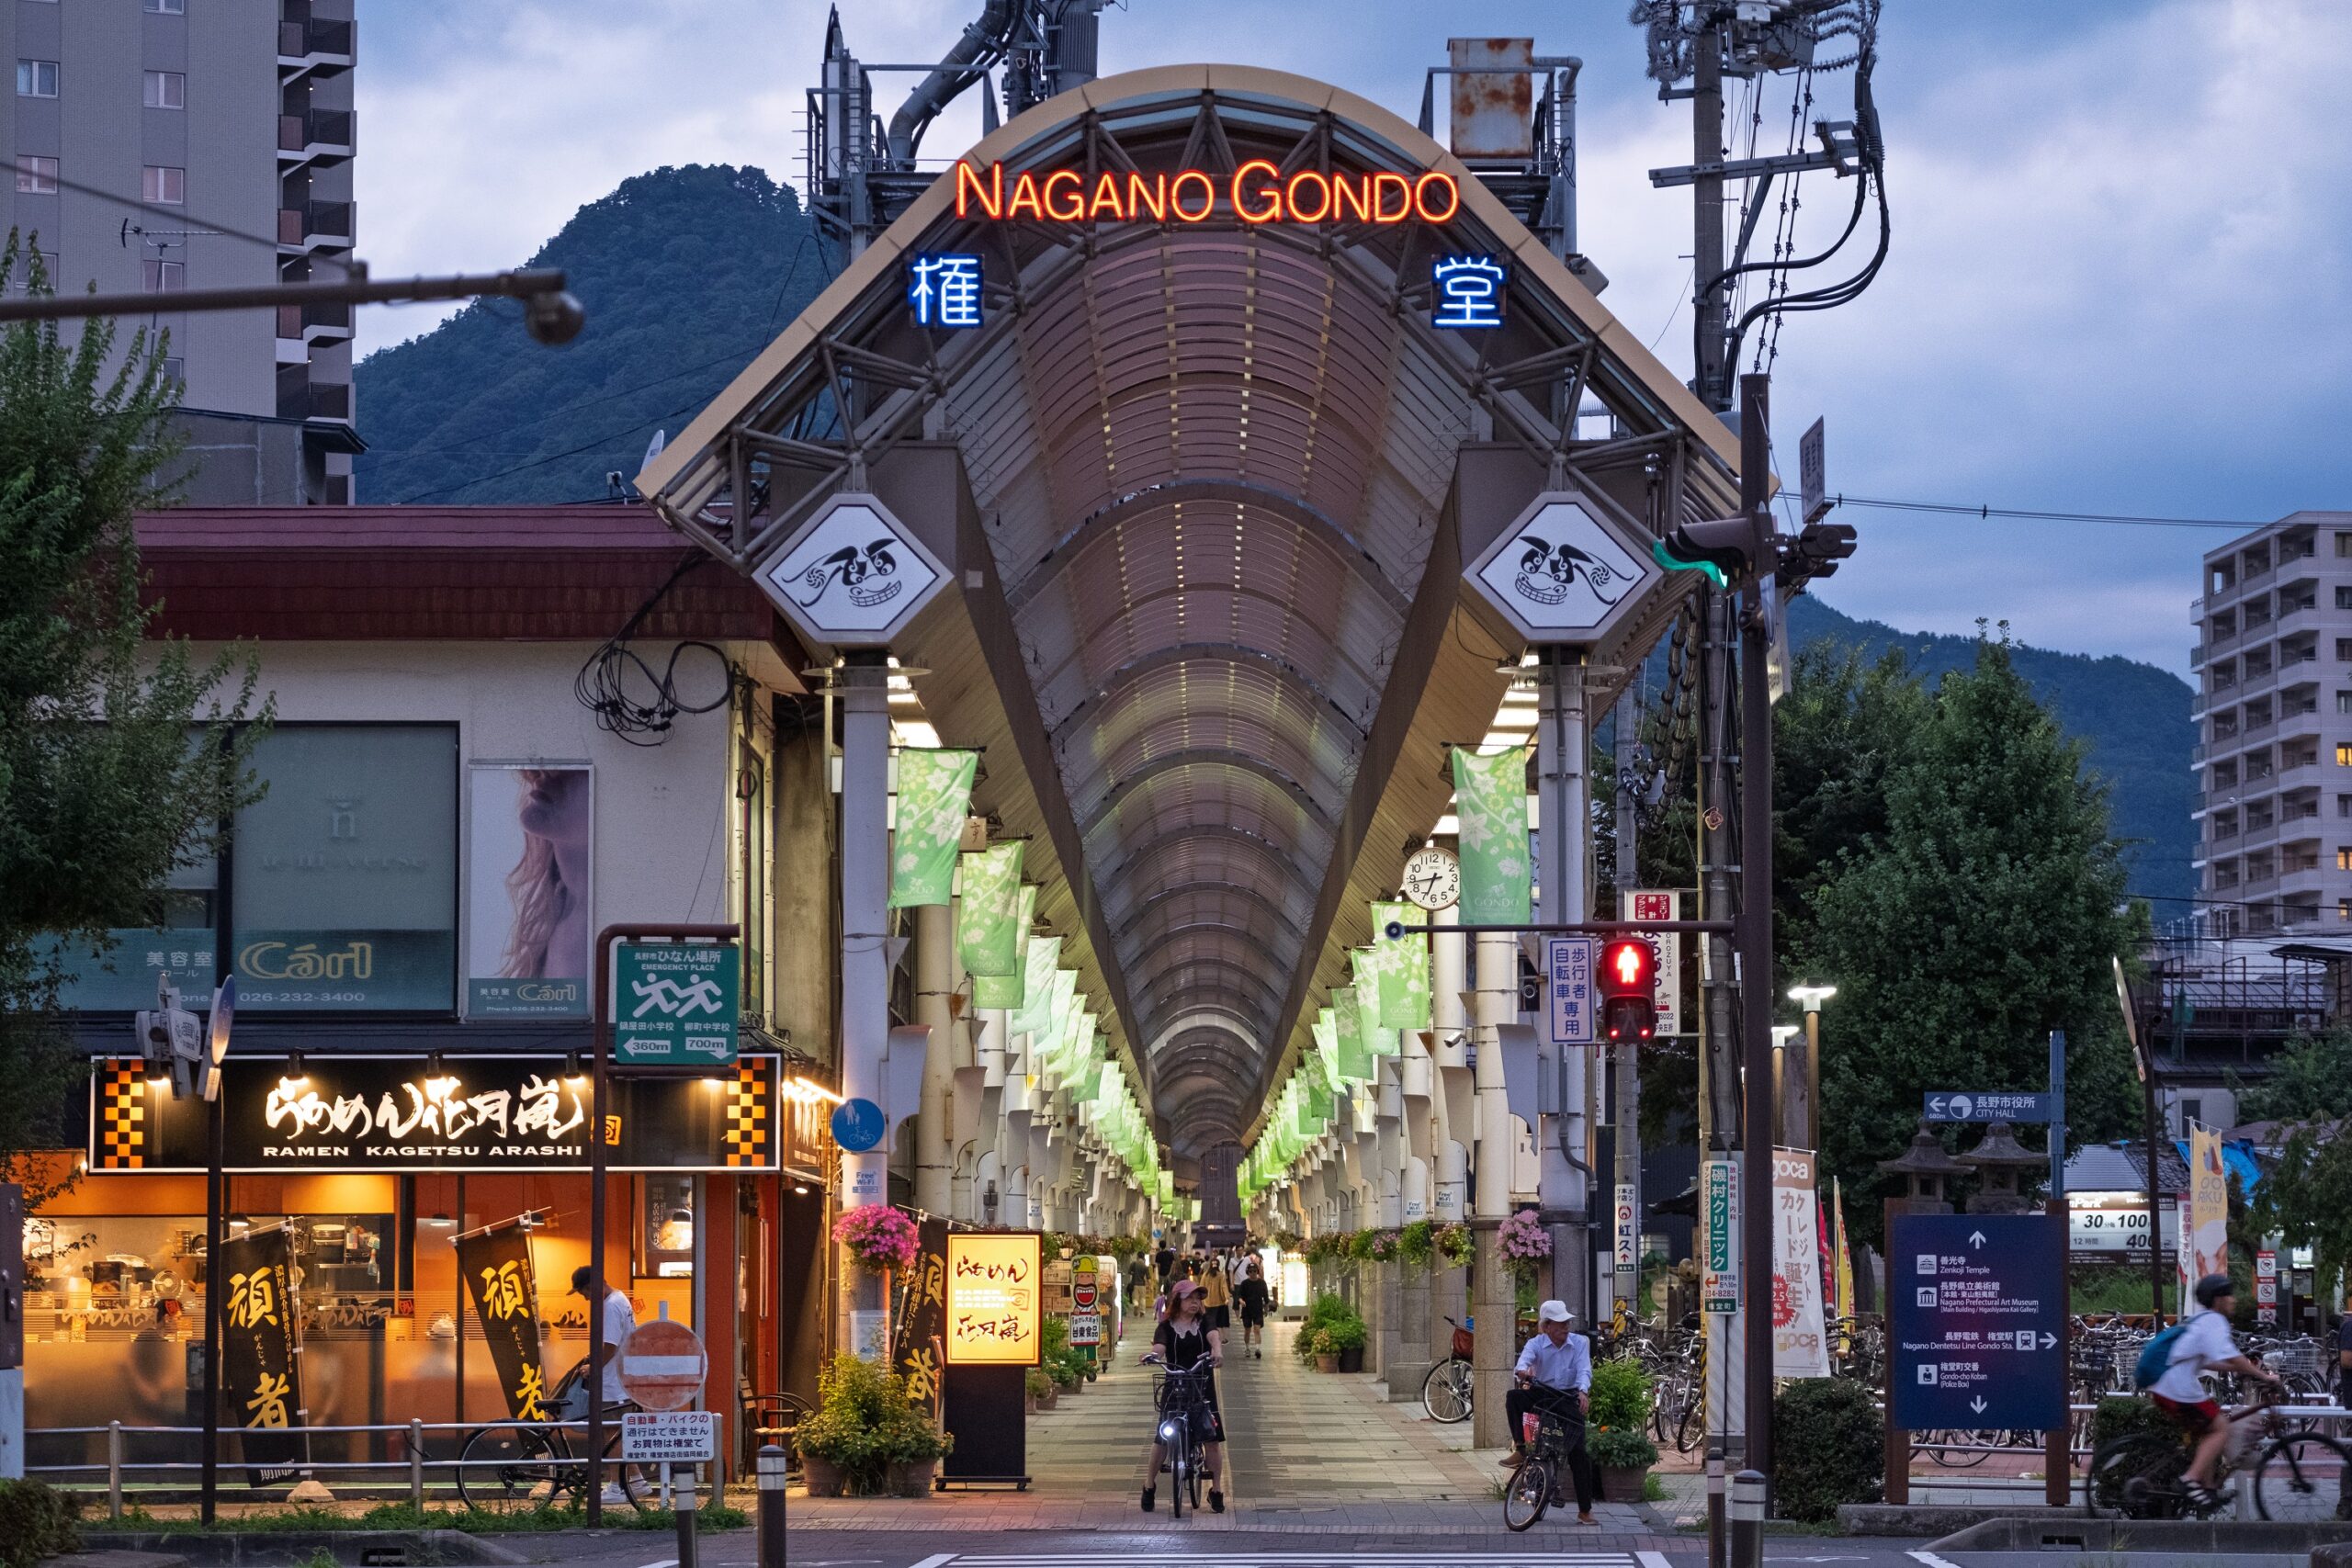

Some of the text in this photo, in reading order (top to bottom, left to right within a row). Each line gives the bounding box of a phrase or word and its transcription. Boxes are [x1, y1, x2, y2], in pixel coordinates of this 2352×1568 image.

[912, 257, 979, 323] 権
[1434, 256, 1503, 325] 堂
[146, 951, 213, 967] 美容室
[1555, 948, 1570, 998] 自転車
[1572, 948, 1586, 998] 歩行者
[240, 992, 366, 1002] 026-232-3400
[1564, 1001, 1580, 1036] 専用
[632, 1042, 670, 1051] 360m
[687, 1039, 726, 1048] 700m
[1975, 1096, 2036, 1109] 長野市役所
[1975, 1109, 2017, 1118] CITY HALL
[263, 1145, 582, 1156] RAMEN KAGETSU ARASHI
[1712, 1168, 1727, 1269] 磯村クリニック
[2084, 1214, 2104, 1228] 30
[2118, 1214, 2148, 1228] 100
[1939, 1257, 1966, 1265] 善光寺
[1939, 1266, 1990, 1275] Zenkoji Temple
[1939, 1281, 2000, 1291] 長野県立美術館
[1939, 1298, 2039, 1307] Nagano Prefectural Art Museum
[1945, 1331, 2014, 1341] 長野電鉄 権堂駅
[1903, 1342, 2014, 1351] Nagano Dentetsu Line Gondo Sta.
[1939, 1362, 1979, 1371] 権堂町交番
[627, 1415, 709, 1425] 自動車・バイクの
[627, 1427, 709, 1437] 通行はできません
[632, 1438, 705, 1449] お買物は権堂で
